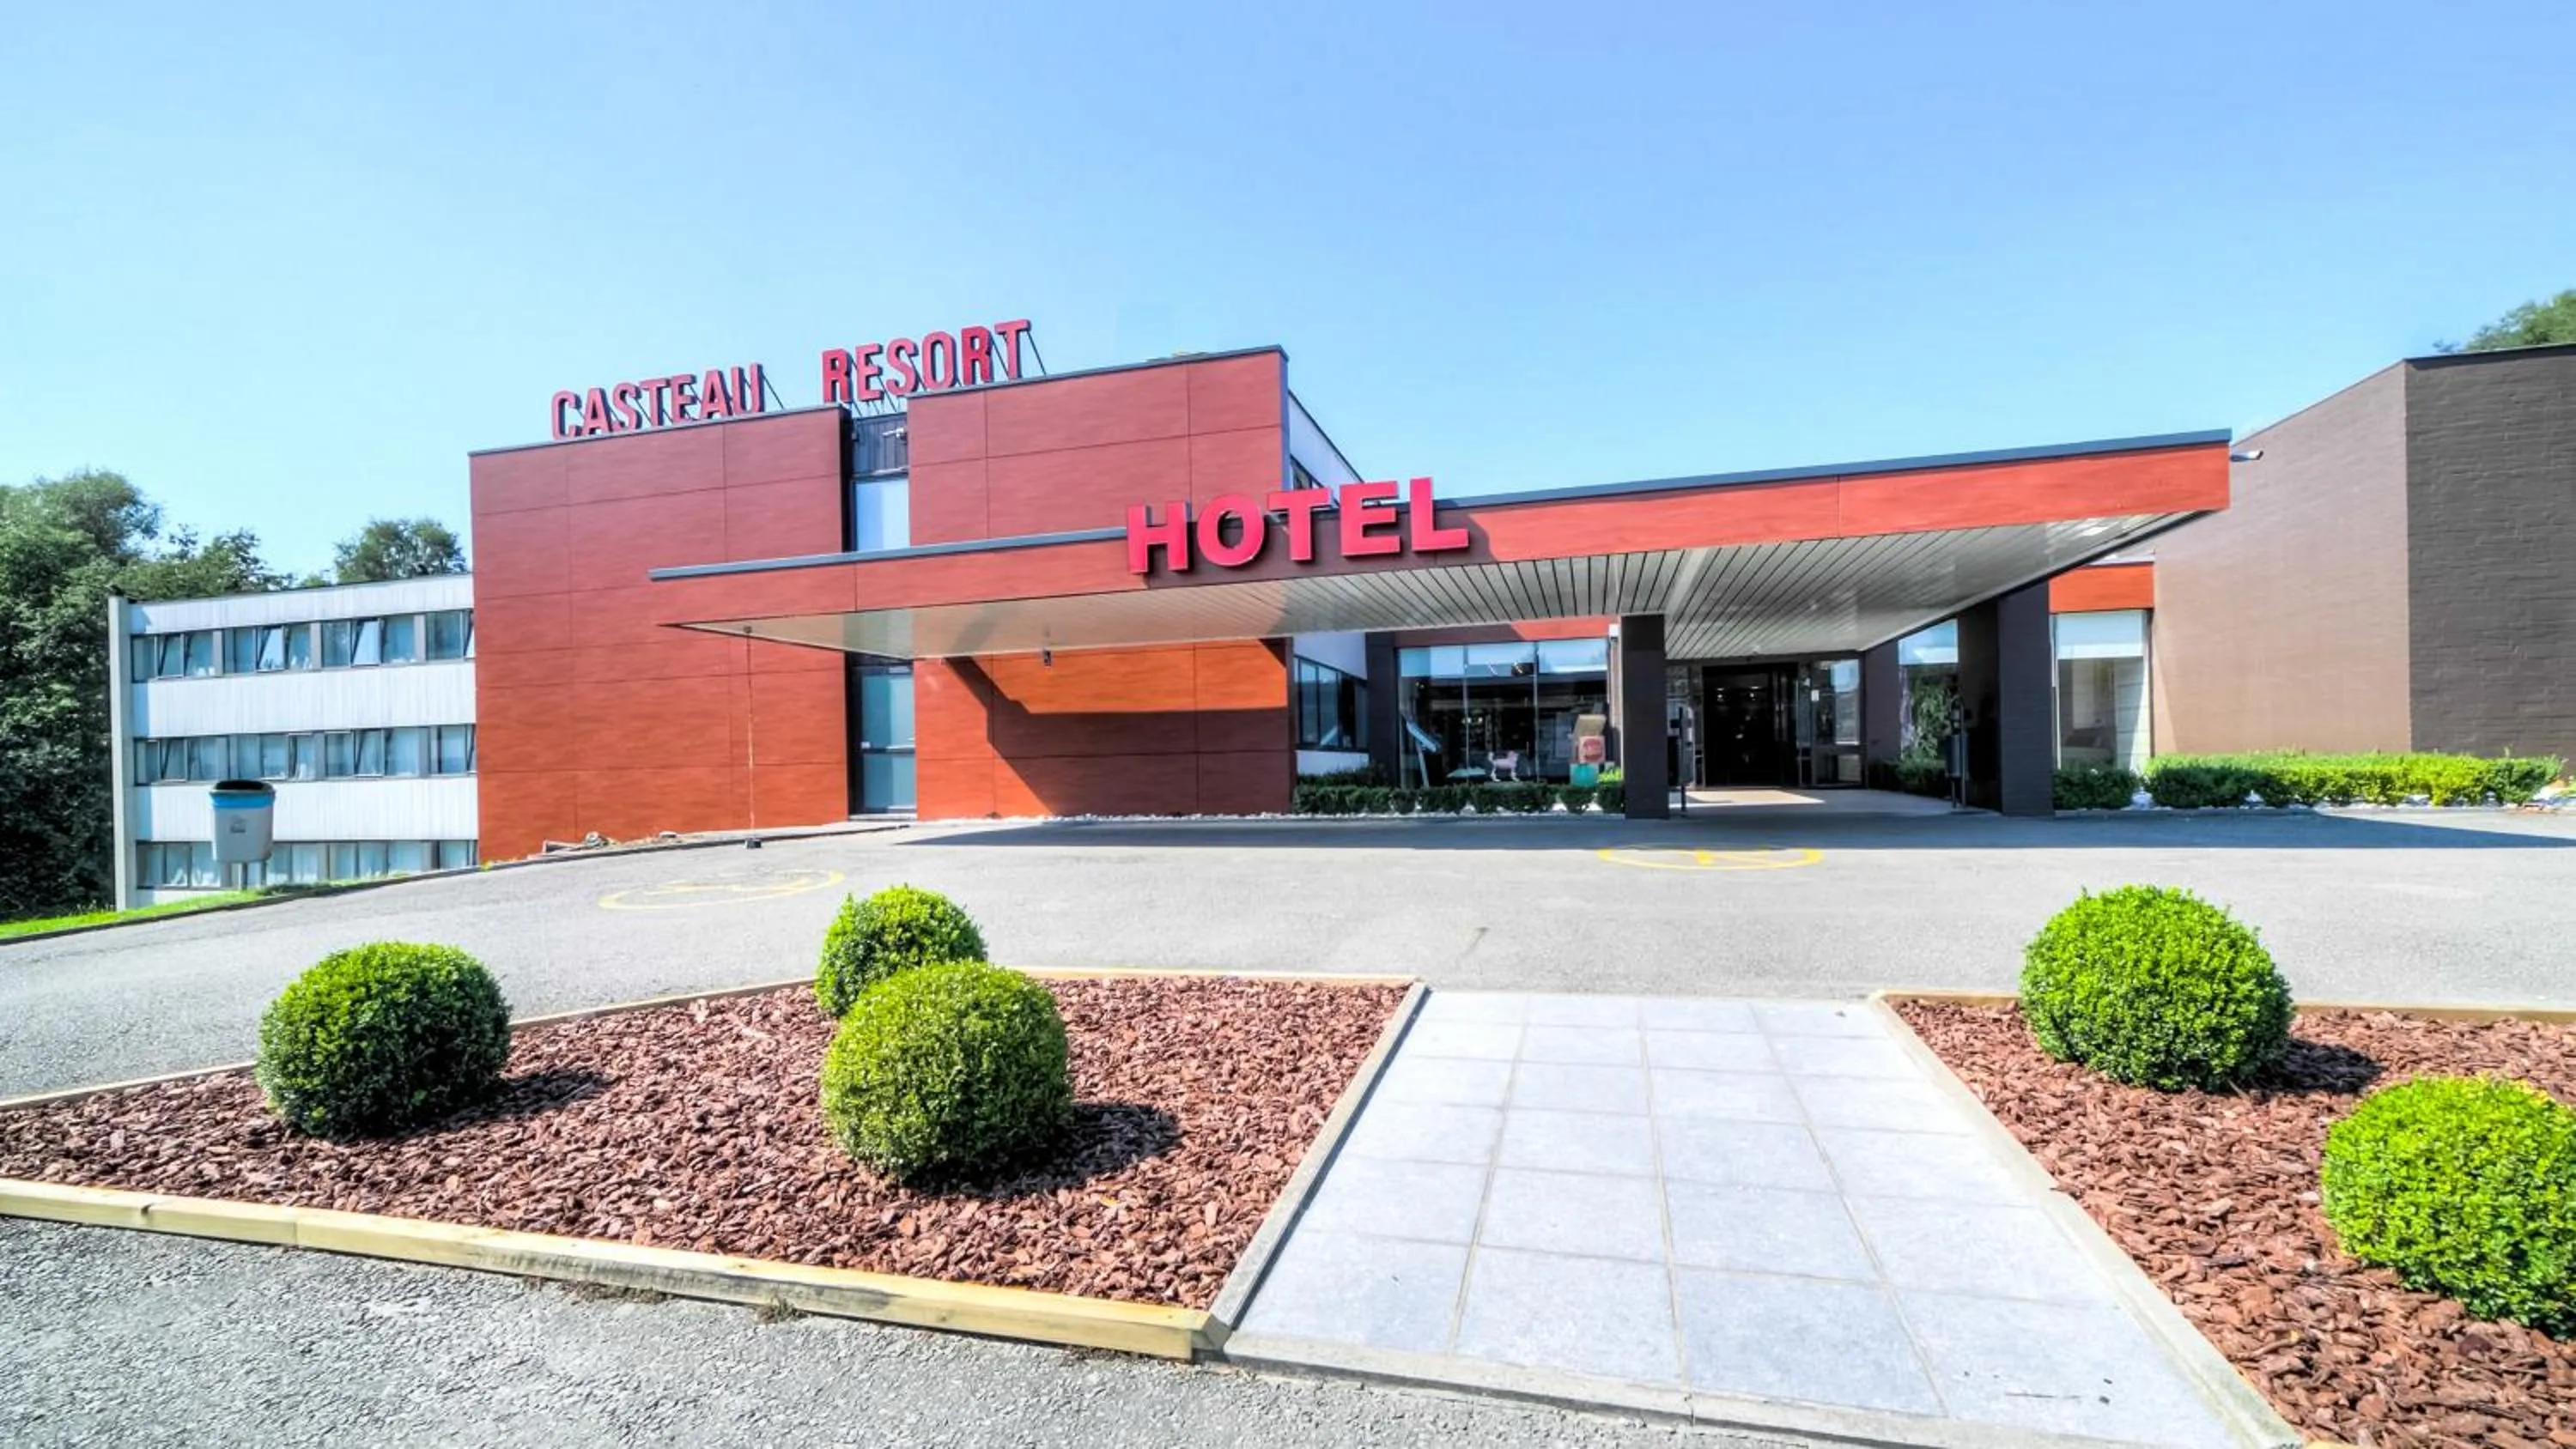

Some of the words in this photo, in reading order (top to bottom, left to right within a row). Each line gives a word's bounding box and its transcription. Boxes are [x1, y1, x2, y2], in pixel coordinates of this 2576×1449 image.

[551, 363, 762, 440] CASTEAU
[822, 319, 1030, 403] RESORT
[1127, 476, 1469, 574] HOTEL
